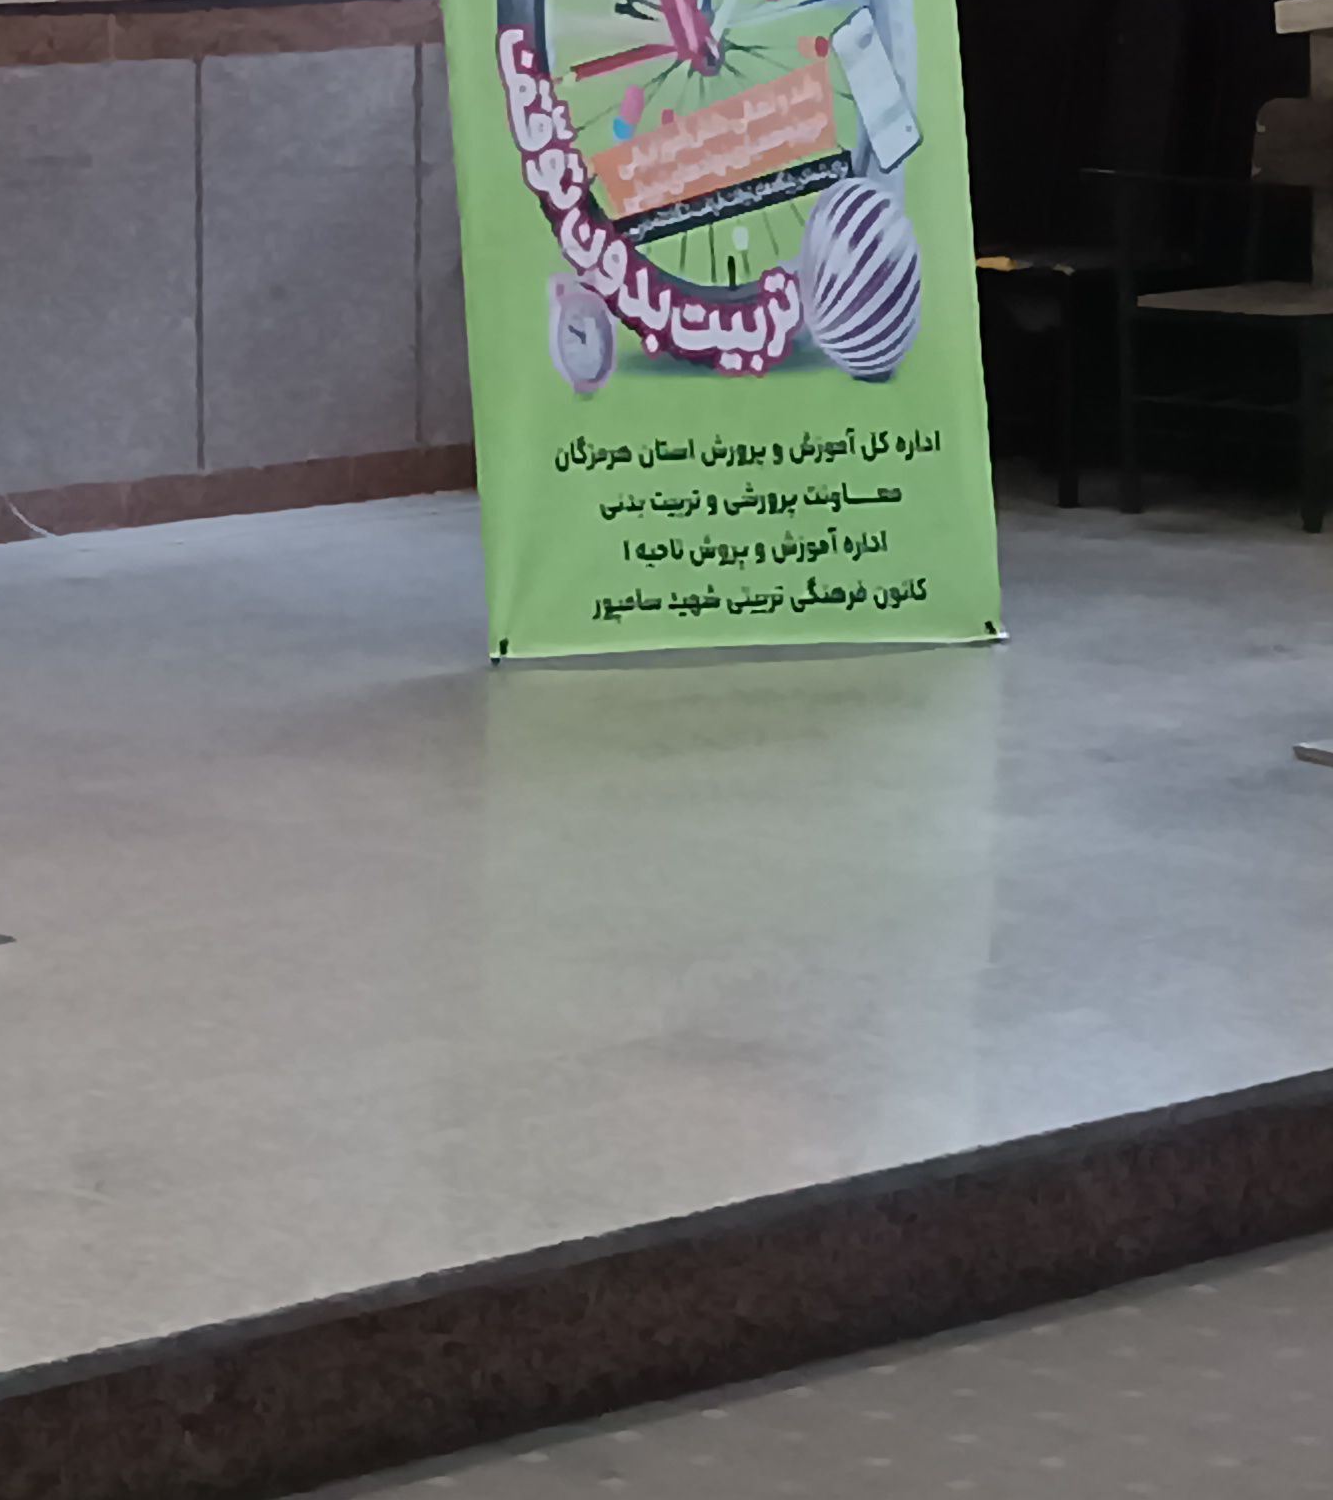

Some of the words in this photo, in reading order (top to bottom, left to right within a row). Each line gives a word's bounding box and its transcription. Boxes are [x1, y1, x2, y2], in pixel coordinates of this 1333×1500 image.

[561, 208, 671, 352] بدون
[671, 273, 801, 371] تربیت
[555, 435, 632, 472] هرمزگان
[638, 438, 695, 468] استان
[701, 434, 766, 470] پرورش
[773, 443, 783, 466] و
[789, 427, 856, 464] آموزش
[861, 431, 889, 462] کل
[896, 428, 941, 461] اداره
[599, 493, 645, 520] بدنی
[650, 489, 701, 518] تربیت
[707, 494, 718, 516] و
[724, 482, 798, 518] پرورشی
[803, 482, 902, 513] معاونت
[636, 538, 683, 568] ناحیه
[755, 542, 766, 565] و
[772, 527, 837, 564] آموزش
[844, 530, 888, 561] اداره
[668, 583, 721, 617] شهید
[790, 576, 868, 613] فرهنگی
[873, 577, 927, 609] کانون
